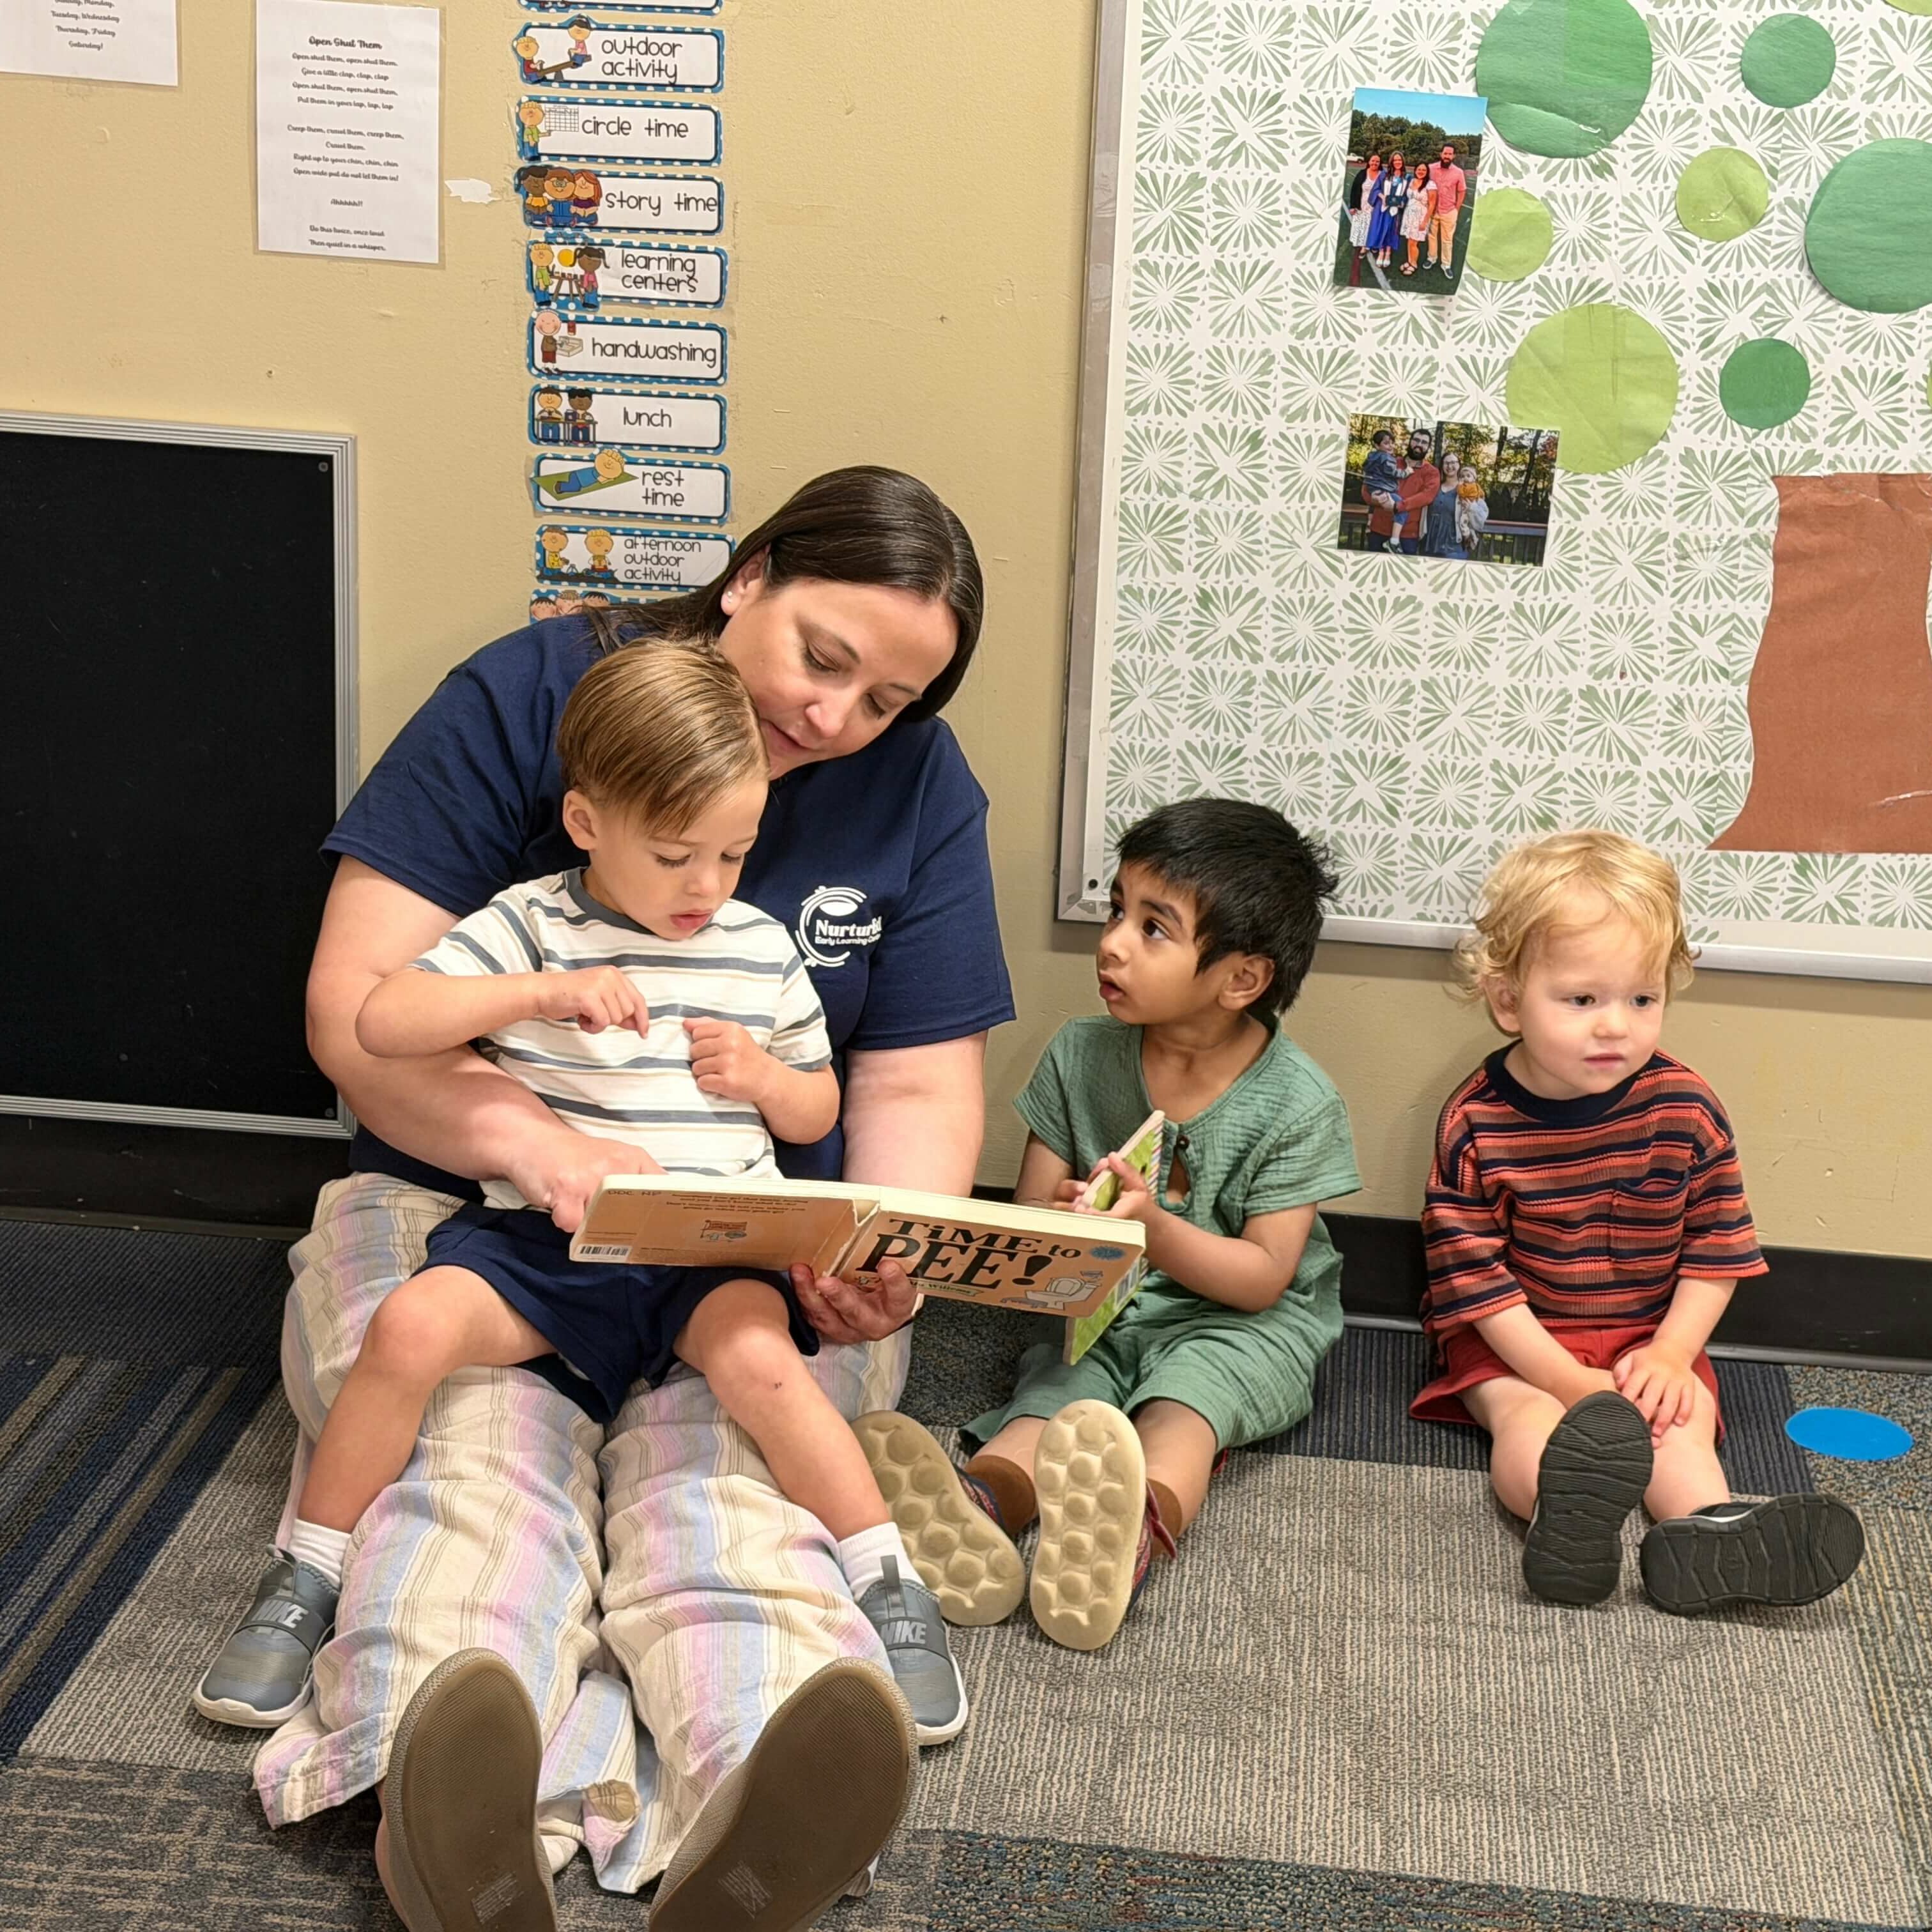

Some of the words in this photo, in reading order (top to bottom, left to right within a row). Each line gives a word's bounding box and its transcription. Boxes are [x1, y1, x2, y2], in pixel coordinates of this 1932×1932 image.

[51, 10, 80, 20] Tuesday,
[82, 13, 119, 23] Wednesday
[56, 26, 90, 36] Thursday,
[91, 28, 116, 38] Friday
[68, 41, 103, 51] Saturday!
[309, 36, 333, 47] Open
[334, 38, 356, 48] Shut
[357, 40, 383, 50] Them
[602, 37, 683, 58] outdoor
[292, 52, 310, 61] Open
[326, 55, 345, 63] them,
[301, 67, 316, 76] Give
[601, 59, 678, 86] activity
[326, 84, 345, 92] them,
[288, 124, 306, 133] Creep
[347, 129, 366, 137] them,
[582, 117, 631, 137] circle
[644, 118, 689, 138] time
[293, 153, 312, 162] Right
[293, 167, 311, 176] Open
[605, 190, 661, 216] story
[673, 192, 717, 213] time
[326, 240, 342, 249] quiet
[621, 249, 696, 278] learning
[621, 272, 697, 293] centers
[592, 338, 717, 368] handwashing
[623, 407, 672, 428] lunch
[641, 470, 685, 487] rest
[641, 488, 685, 507] time
[624, 537, 701, 553] afternoon
[624, 553, 685, 567] outdoor
[624, 567, 681, 585] activity
[1048, 1245, 1082, 1259] to
[855, 1232, 1053, 1290] PEE!
[251, 1599, 309, 1629] NIKE
[880, 1620, 928, 1645] NIKE
